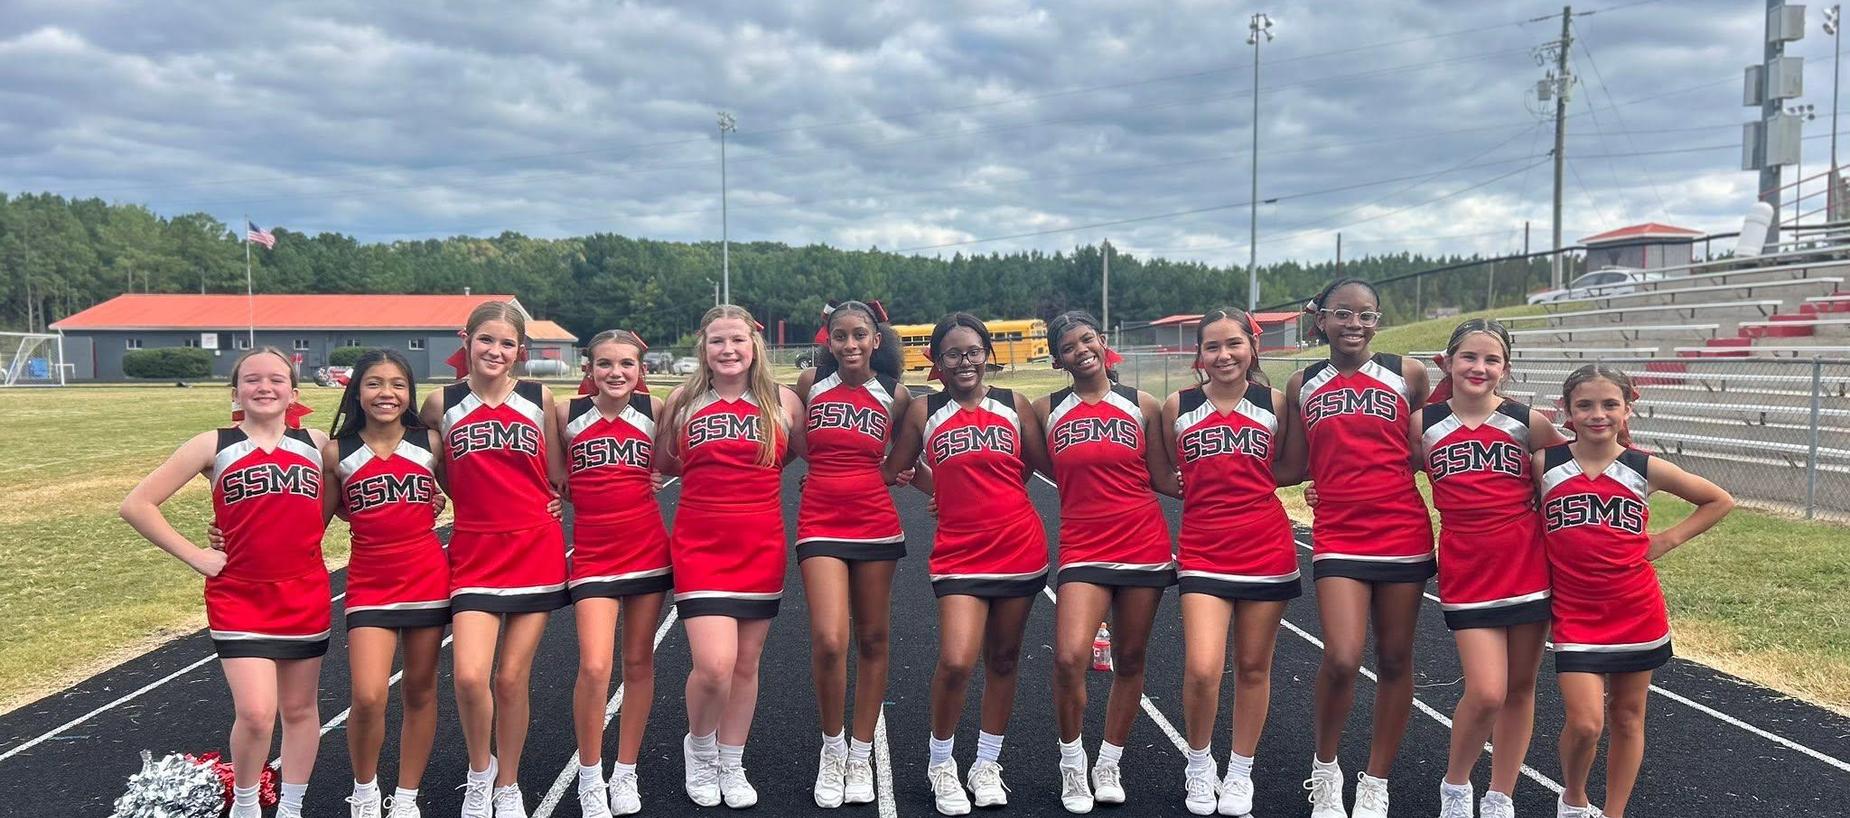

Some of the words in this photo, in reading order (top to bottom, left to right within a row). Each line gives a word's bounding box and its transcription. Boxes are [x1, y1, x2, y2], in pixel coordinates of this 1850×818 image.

[807, 402, 887, 443] SSMS
[1302, 388, 1398, 431] SSMS
[449, 421, 540, 460] SSMS
[571, 437, 652, 474] SSMS
[932, 425, 1016, 464] SSMS
[1054, 417, 1138, 455] SSMS
[1181, 425, 1273, 463] SSMS
[1429, 440, 1523, 482] SSMS
[222, 464, 321, 506] SSMS
[346, 473, 434, 513] SSMS
[1544, 492, 1645, 535] SSMS
[1093, 647, 1101, 658] G
